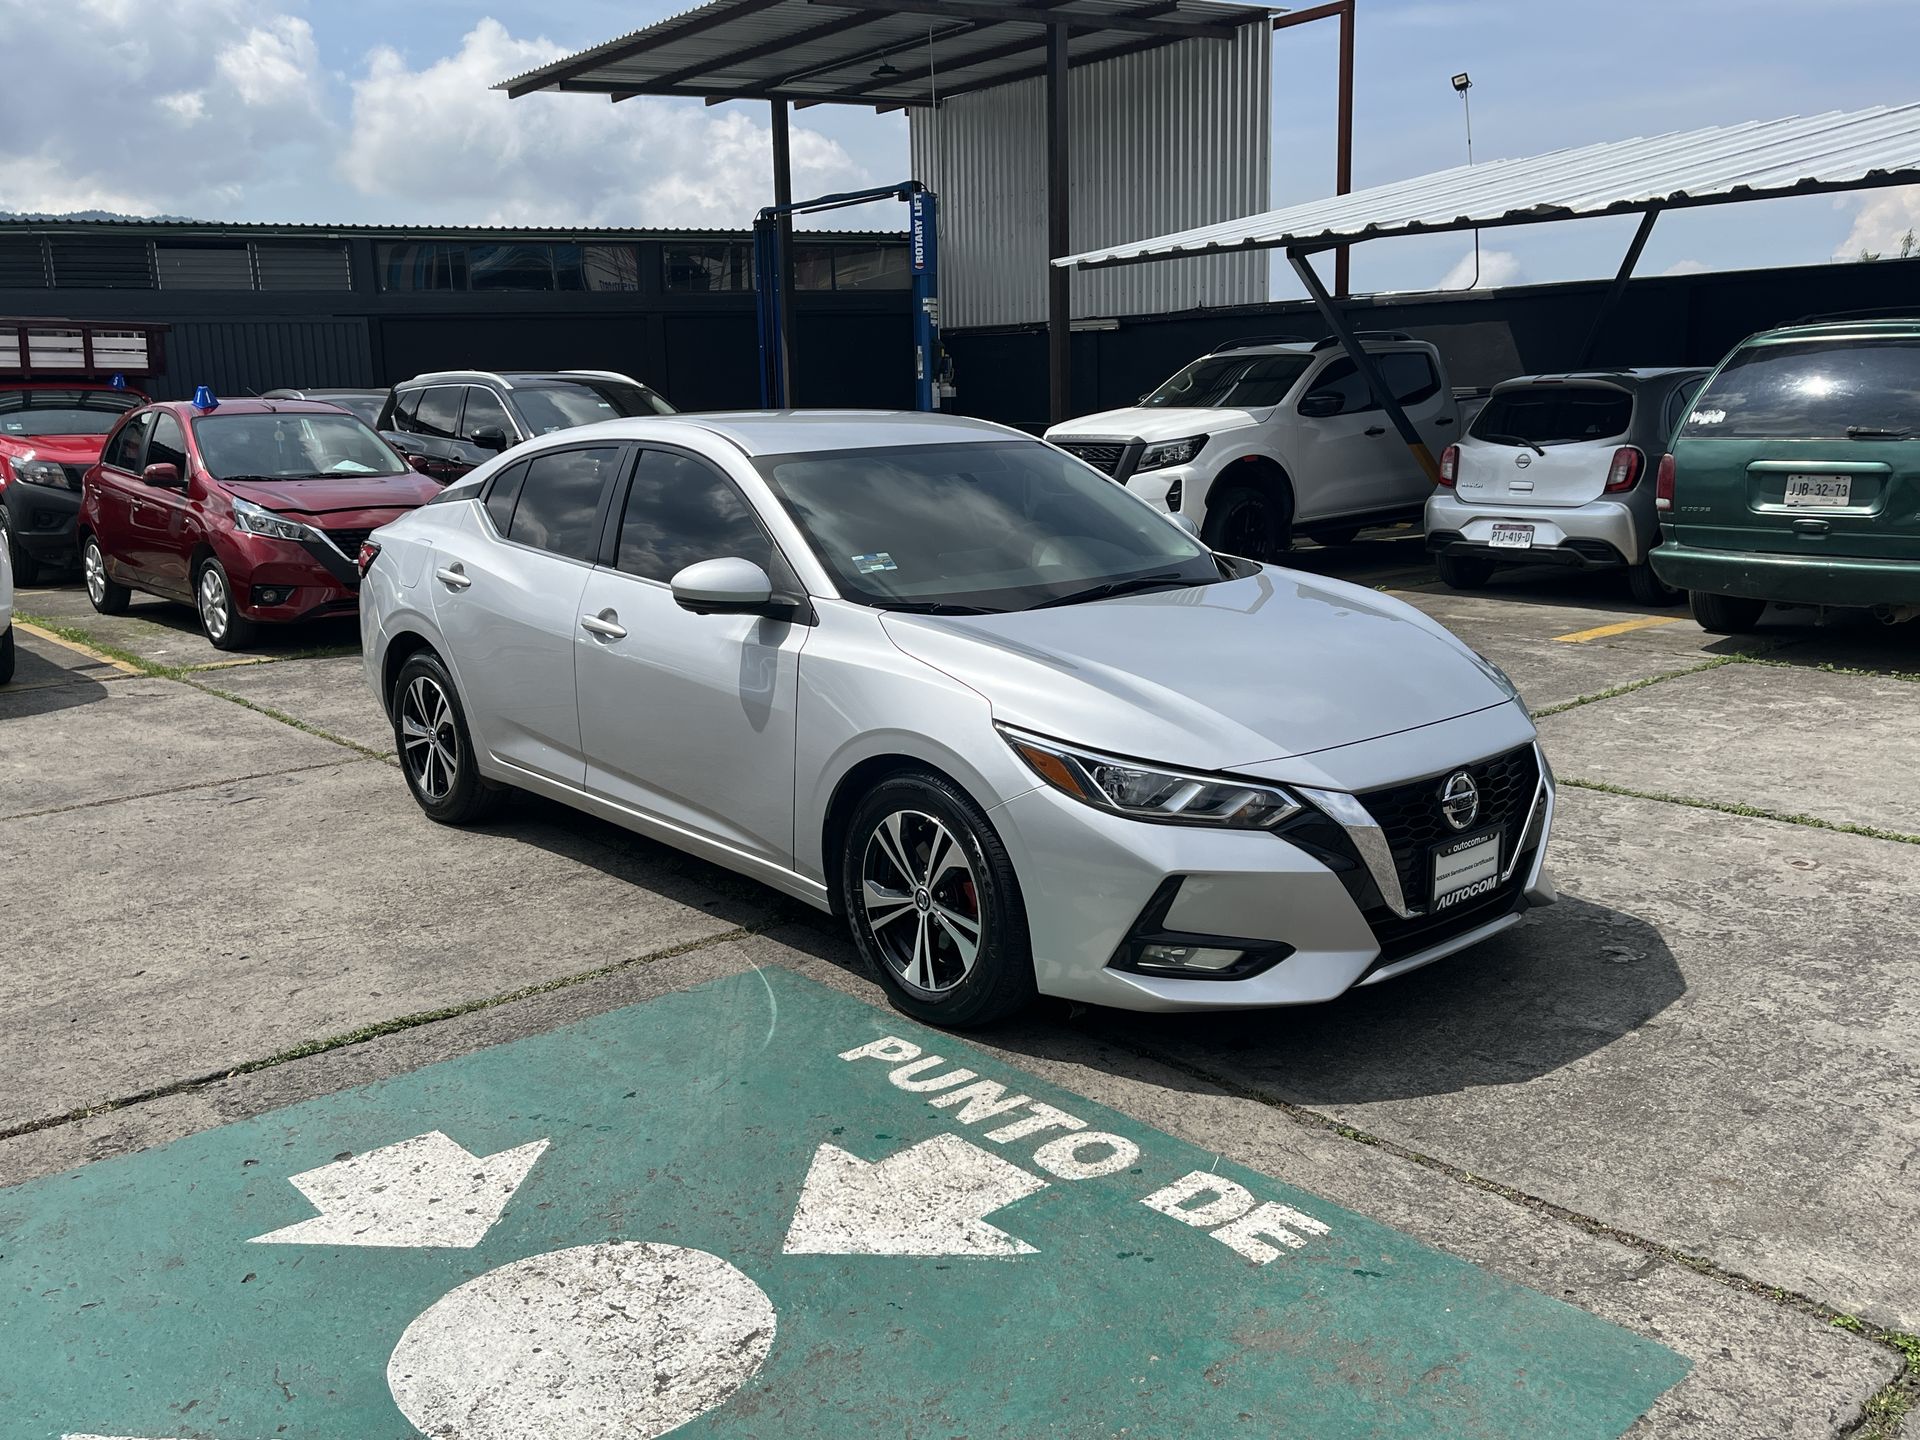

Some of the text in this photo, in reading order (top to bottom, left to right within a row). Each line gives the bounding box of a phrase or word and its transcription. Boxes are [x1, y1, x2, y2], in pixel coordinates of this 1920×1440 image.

[913, 193, 924, 263] ROTARY LIFT
[1789, 482, 1848, 497] JJB-32-73
[1491, 531, 1531, 543] PTJ-419-D
[1436, 875, 1498, 911] AUTOCOM
[837, 1035, 1332, 1266] PUNTO DE
